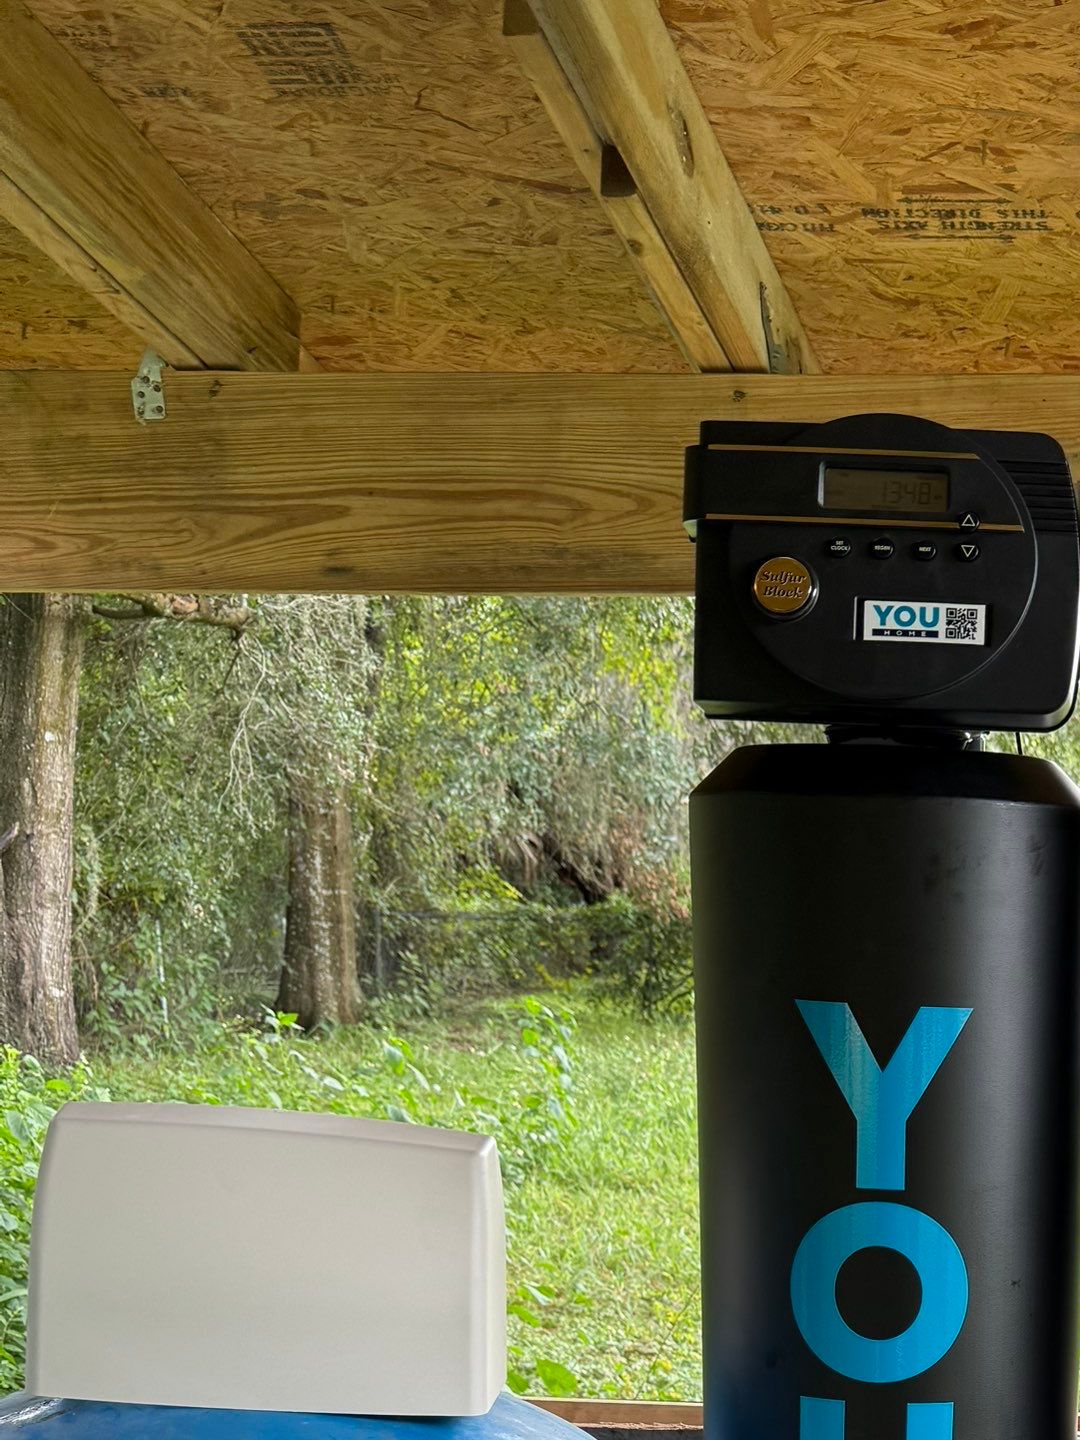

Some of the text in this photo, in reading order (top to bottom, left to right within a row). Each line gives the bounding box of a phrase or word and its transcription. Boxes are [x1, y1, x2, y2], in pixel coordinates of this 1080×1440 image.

[861, 208, 1048, 220] THIS DIRECTION
[877, 220, 1049, 232] STRENGTH AXIS
[760, 570, 807, 585] Sulfur
[763, 586, 803, 599] Block
[873, 604, 940, 628] YOU
